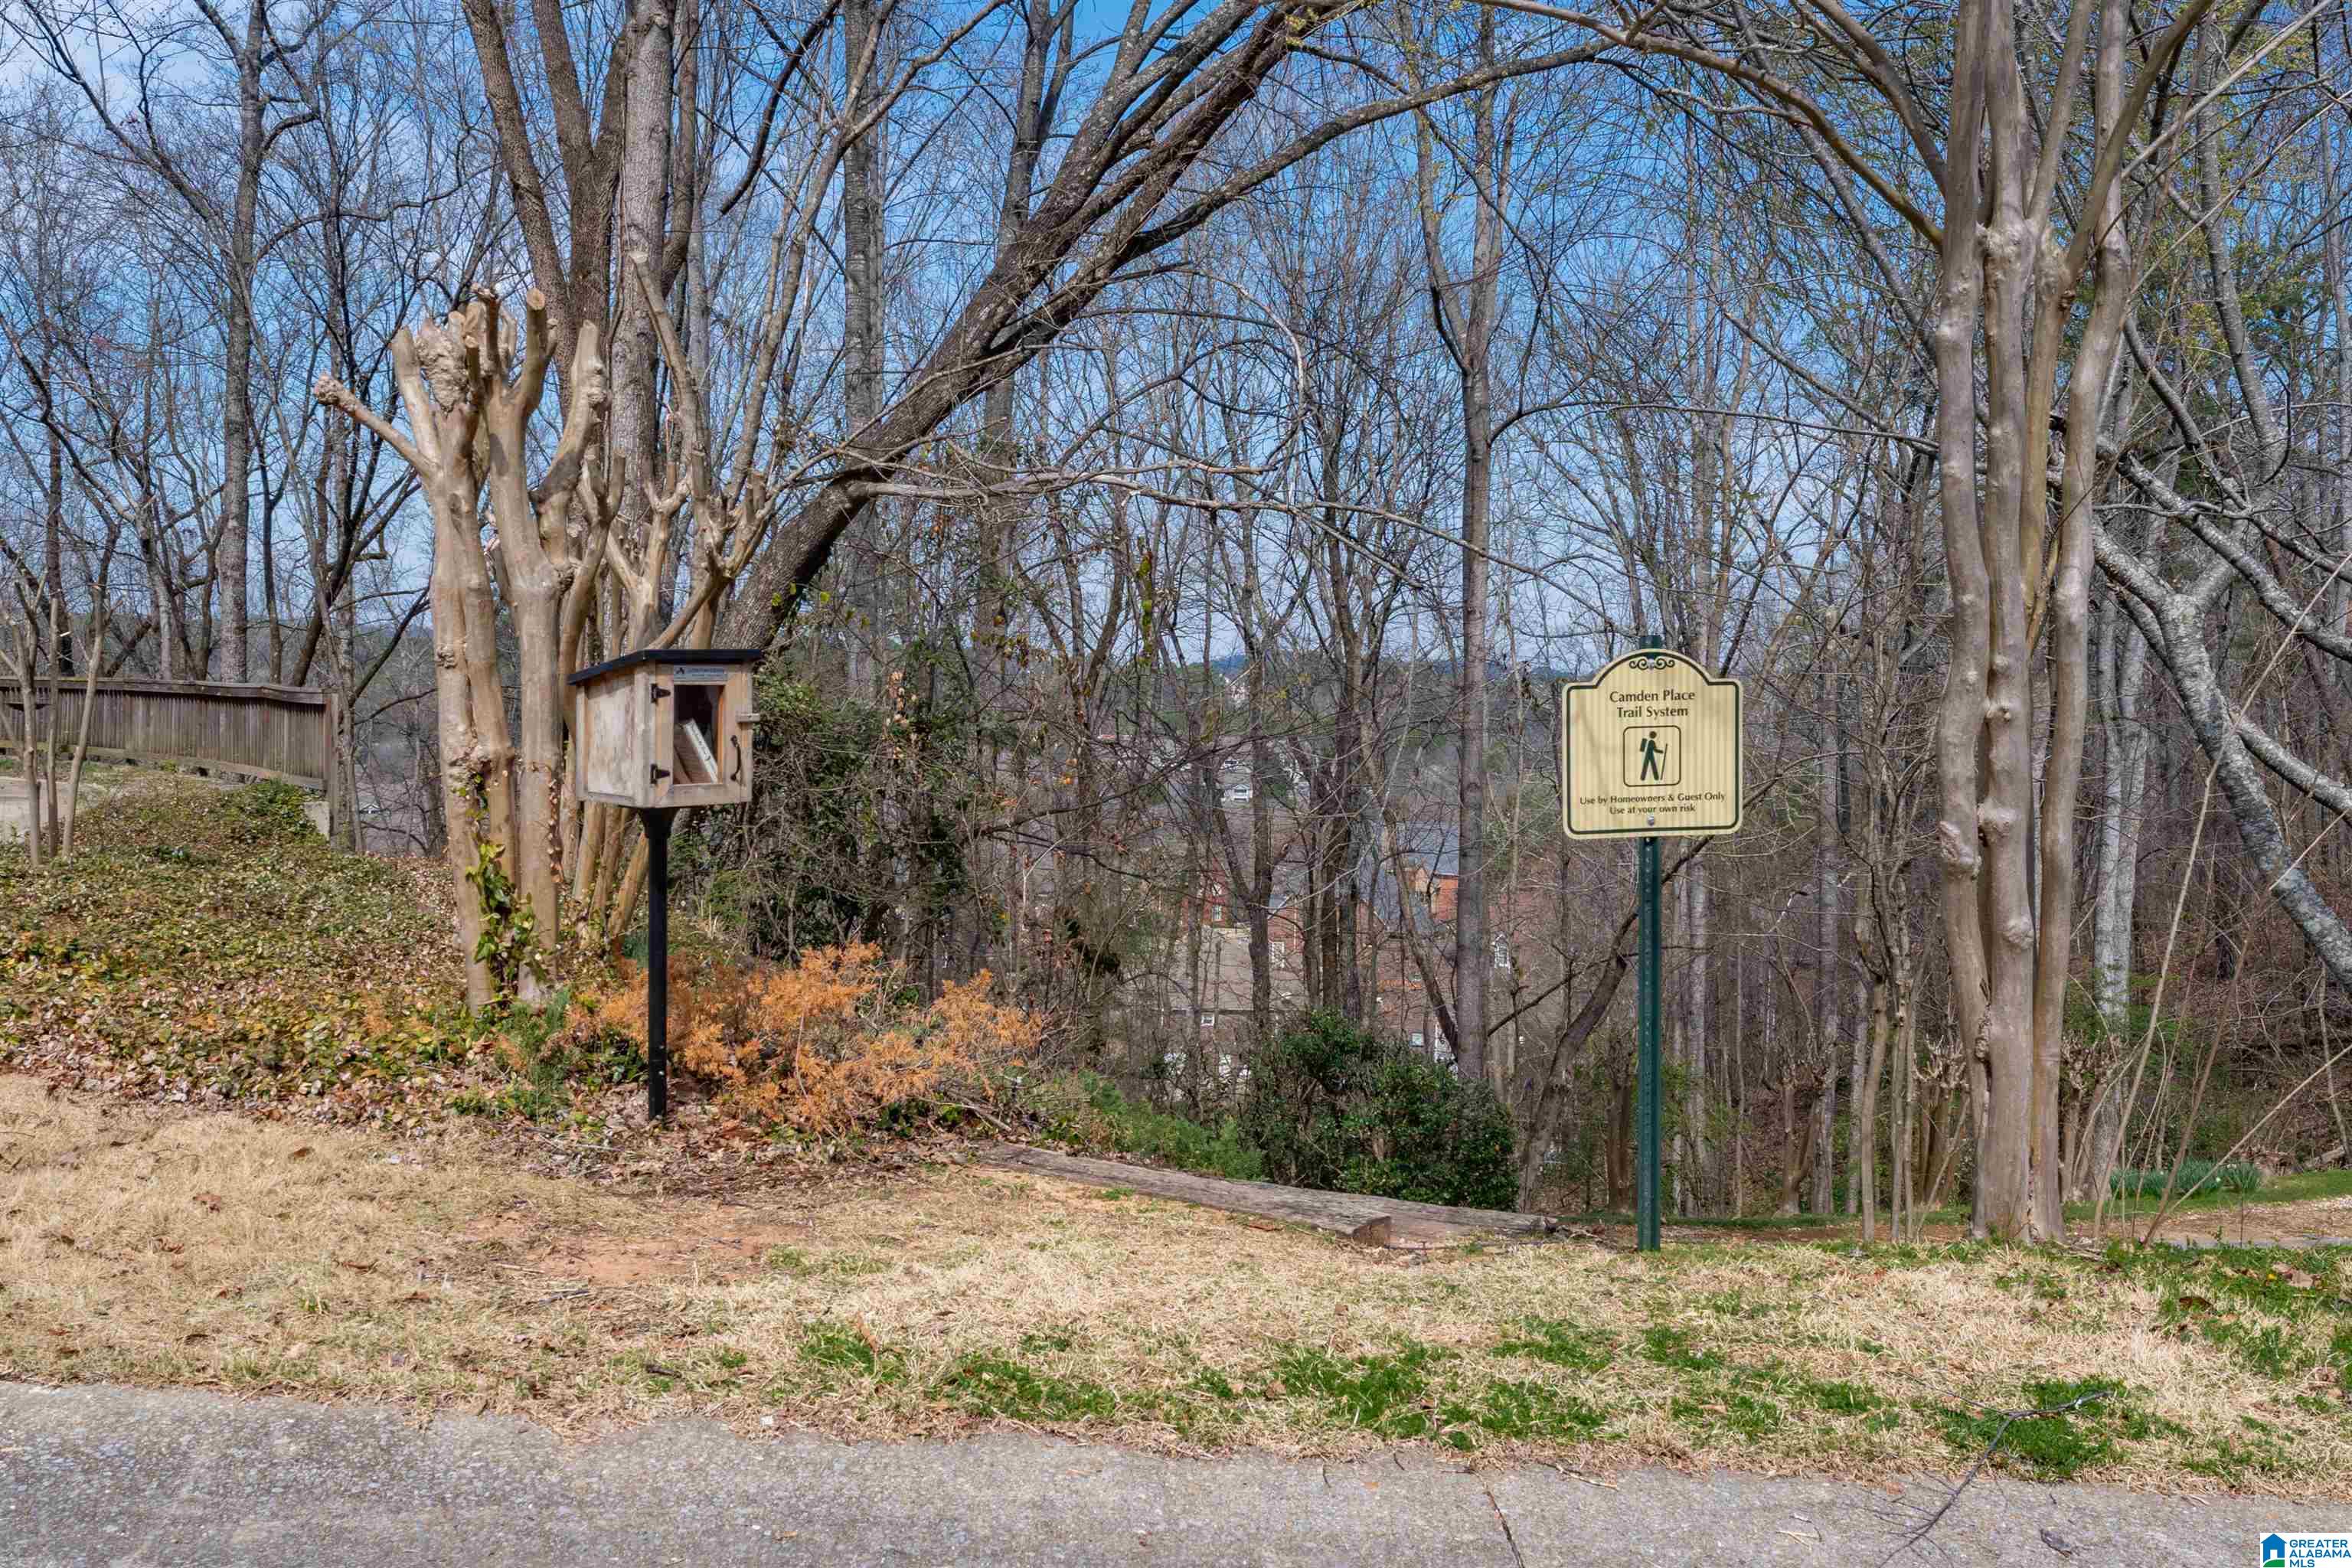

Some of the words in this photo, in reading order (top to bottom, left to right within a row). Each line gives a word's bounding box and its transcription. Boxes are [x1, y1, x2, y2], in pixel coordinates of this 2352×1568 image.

[1609, 690, 1658, 703] Camden
[1663, 689, 1695, 701] Place
[1617, 706, 1642, 718] Trail
[1646, 706, 1689, 720] System
[1579, 796, 1596, 805] Use
[1597, 795, 1608, 804] by
[1668, 793, 1674, 802] &
[1677, 793, 1702, 802] Guest
[1704, 792, 1725, 801] Only
[1609, 806, 1625, 815] Use
[1638, 806, 1657, 815] your
[1680, 804, 1695, 812] risk
